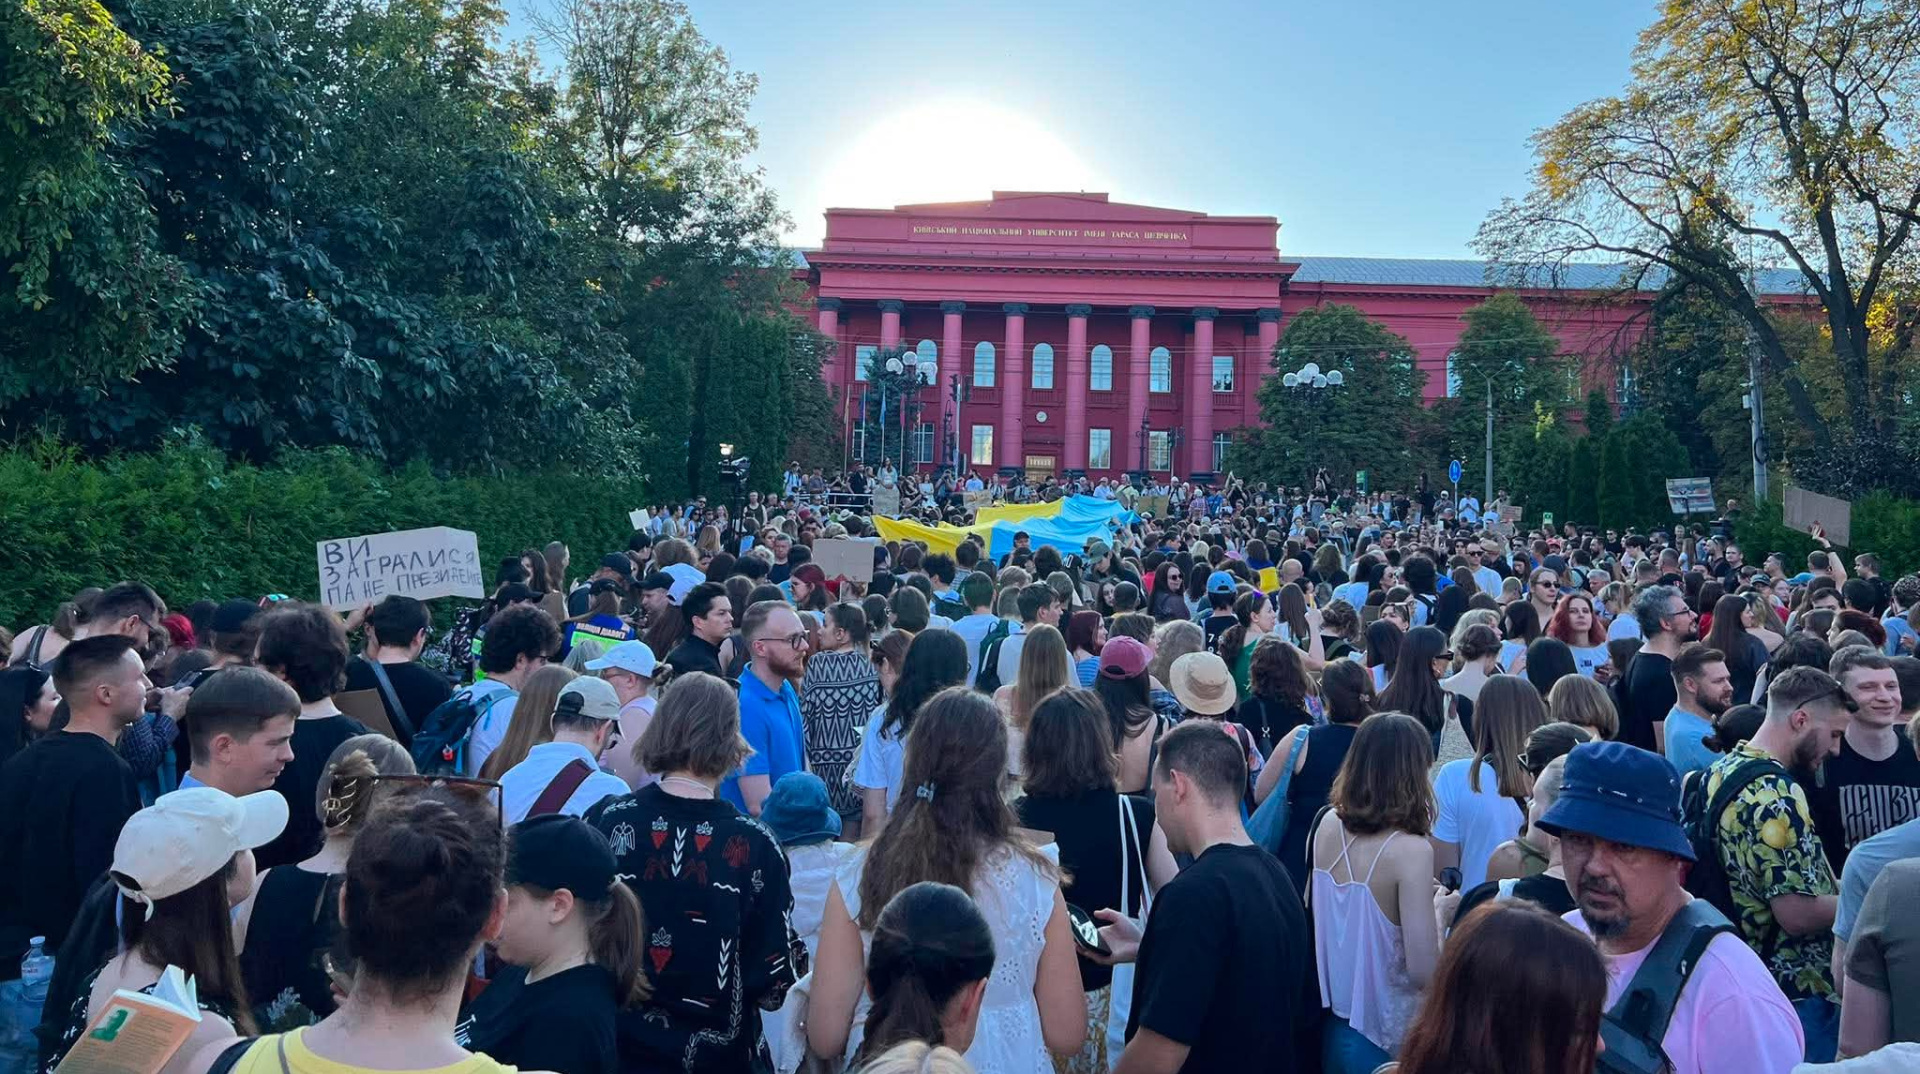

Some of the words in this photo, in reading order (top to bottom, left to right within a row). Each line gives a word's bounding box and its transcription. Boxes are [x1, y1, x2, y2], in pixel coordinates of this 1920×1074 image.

[1027, 228, 1079, 237] УНІВЕРСИТЕТ
[1084, 230, 1106, 238] ІМЕНІ
[1111, 230, 1140, 239] ТАРАСА
[1144, 231, 1187, 240] ШЕВЧЕНКА
[324, 537, 371, 565] ВИ
[324, 549, 475, 585] ЗАГРАЛИСЯ
